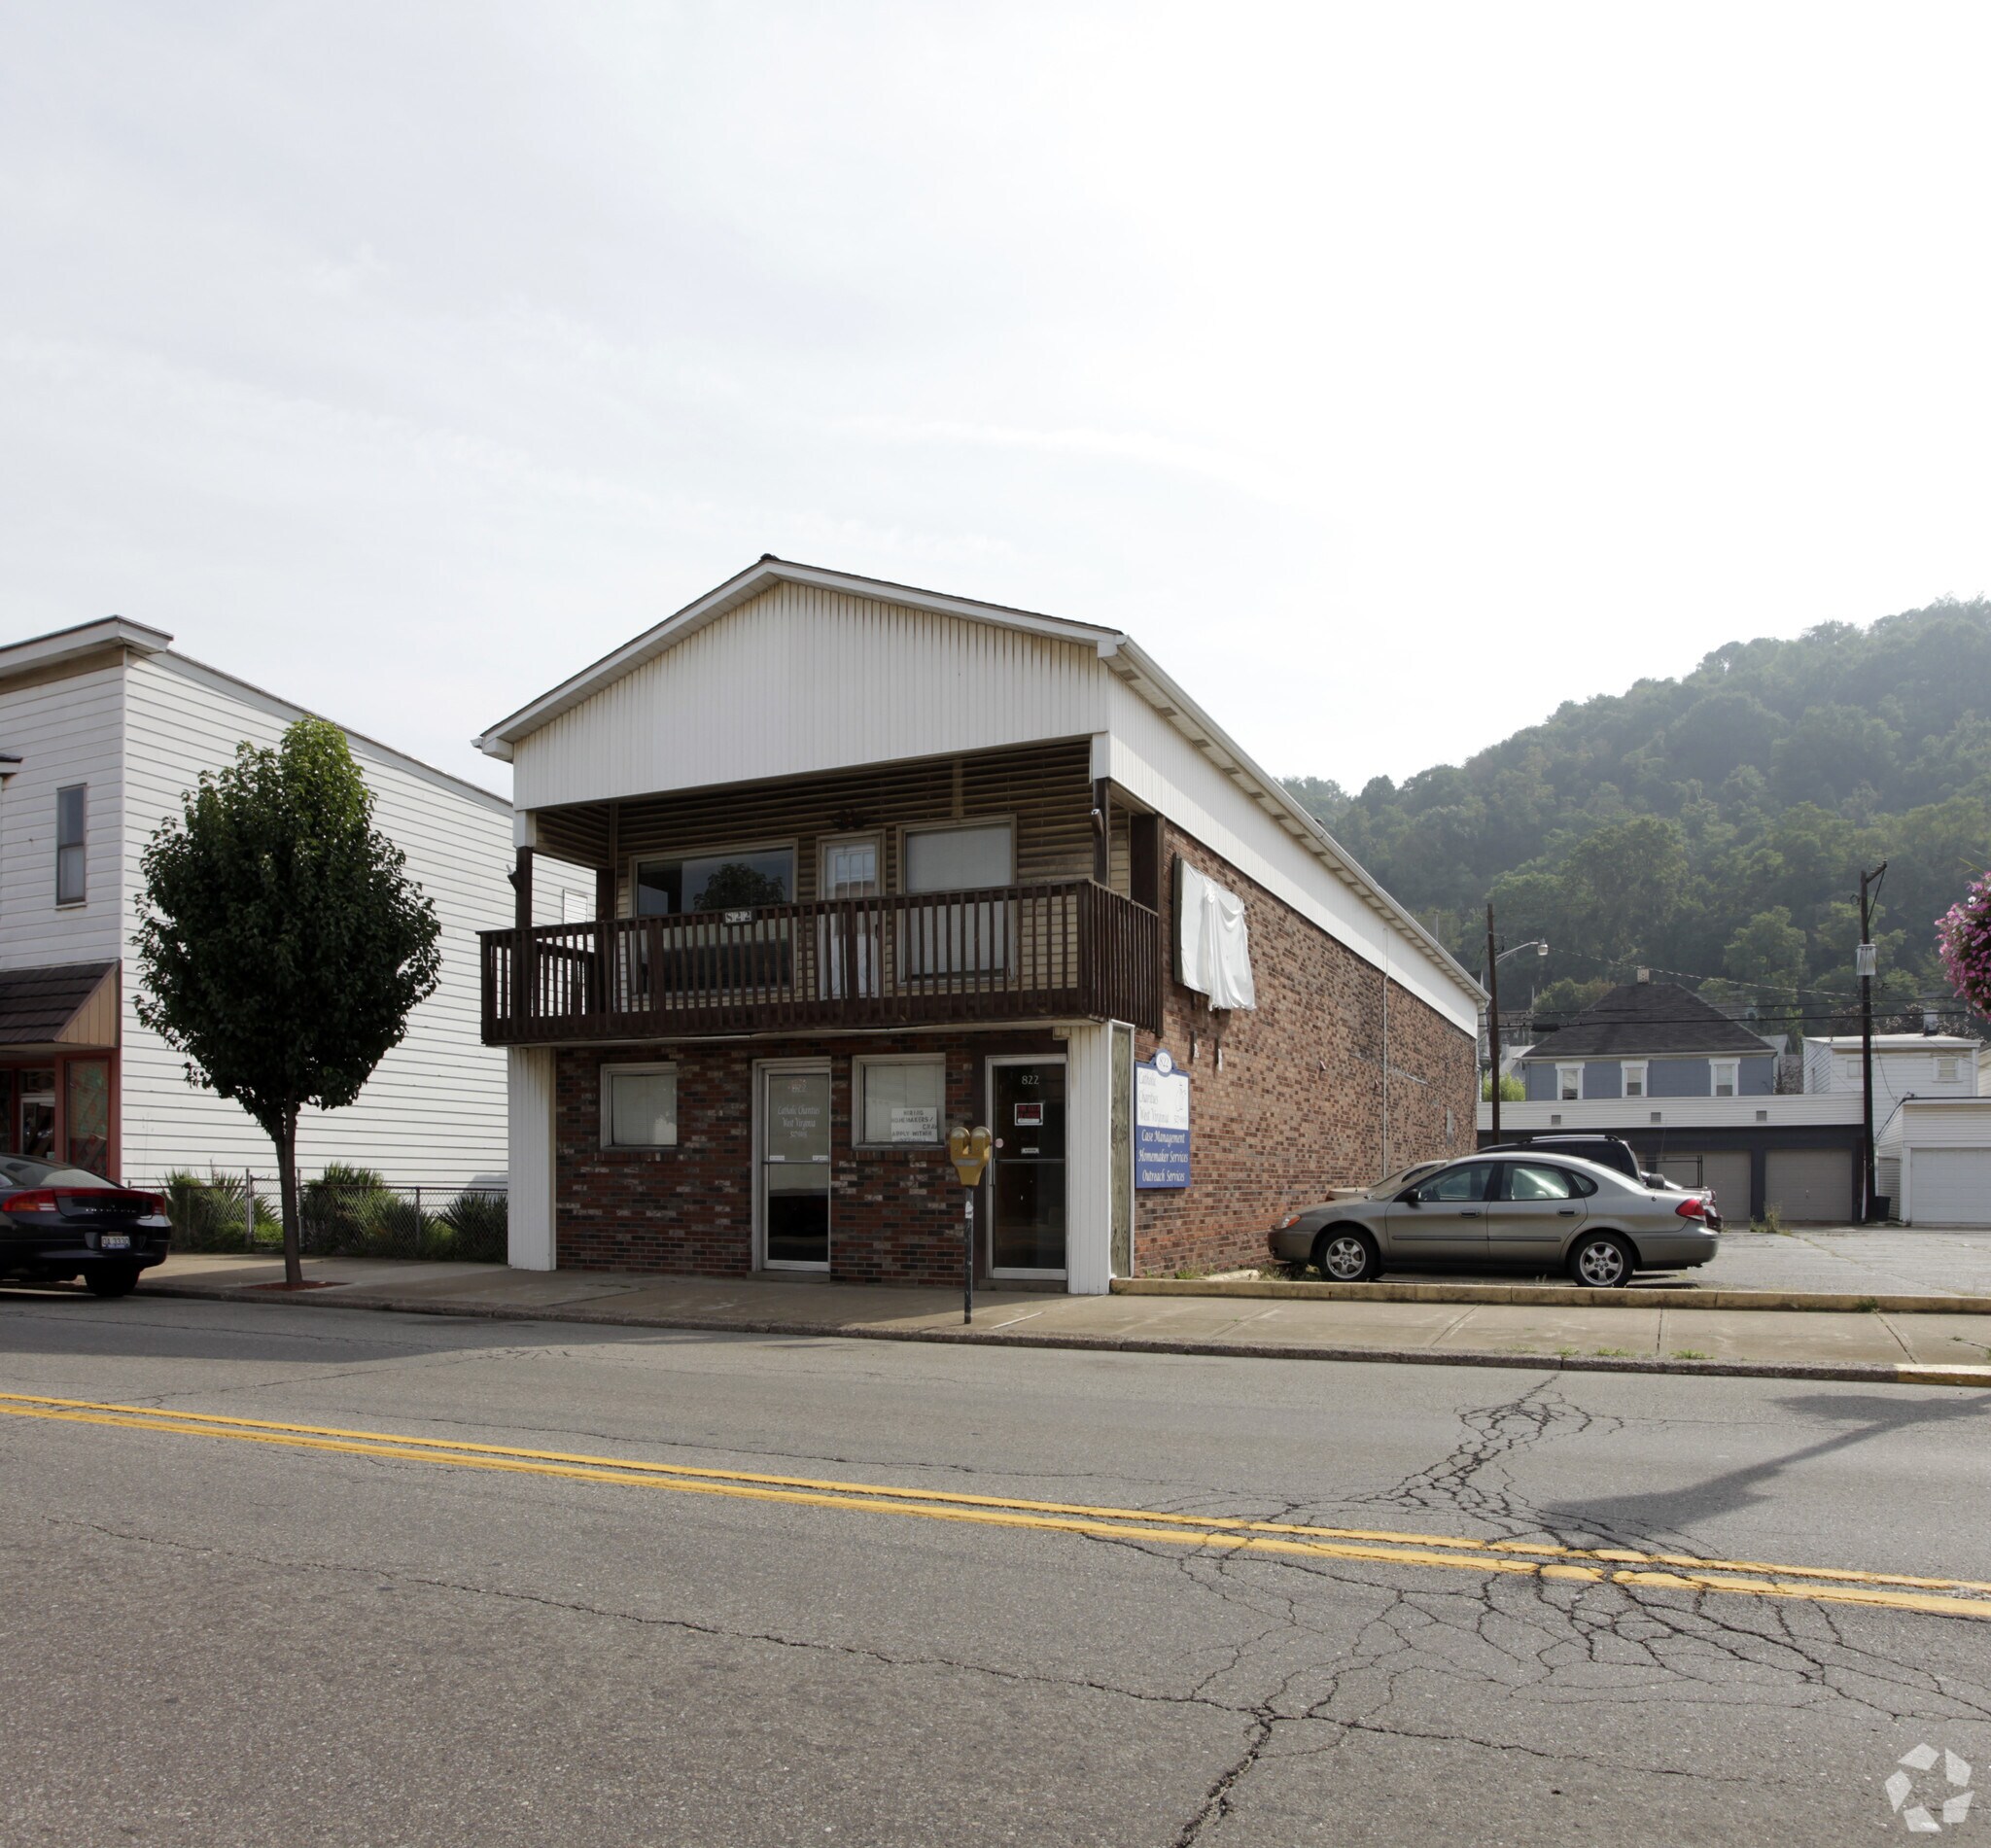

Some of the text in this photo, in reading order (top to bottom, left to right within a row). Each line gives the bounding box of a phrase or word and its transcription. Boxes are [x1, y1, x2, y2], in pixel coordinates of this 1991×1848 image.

[726, 911, 751, 923] 822
[1022, 1075, 1039, 1085] 822
[778, 1105, 820, 1115] Catholic Charities
[783, 1117, 816, 1130] West Virginia
[1141, 1129, 1185, 1147] Case Management
[1138, 1148, 1188, 1163] Homemaker Services
[1142, 1168, 1185, 1182] Outreach Services
